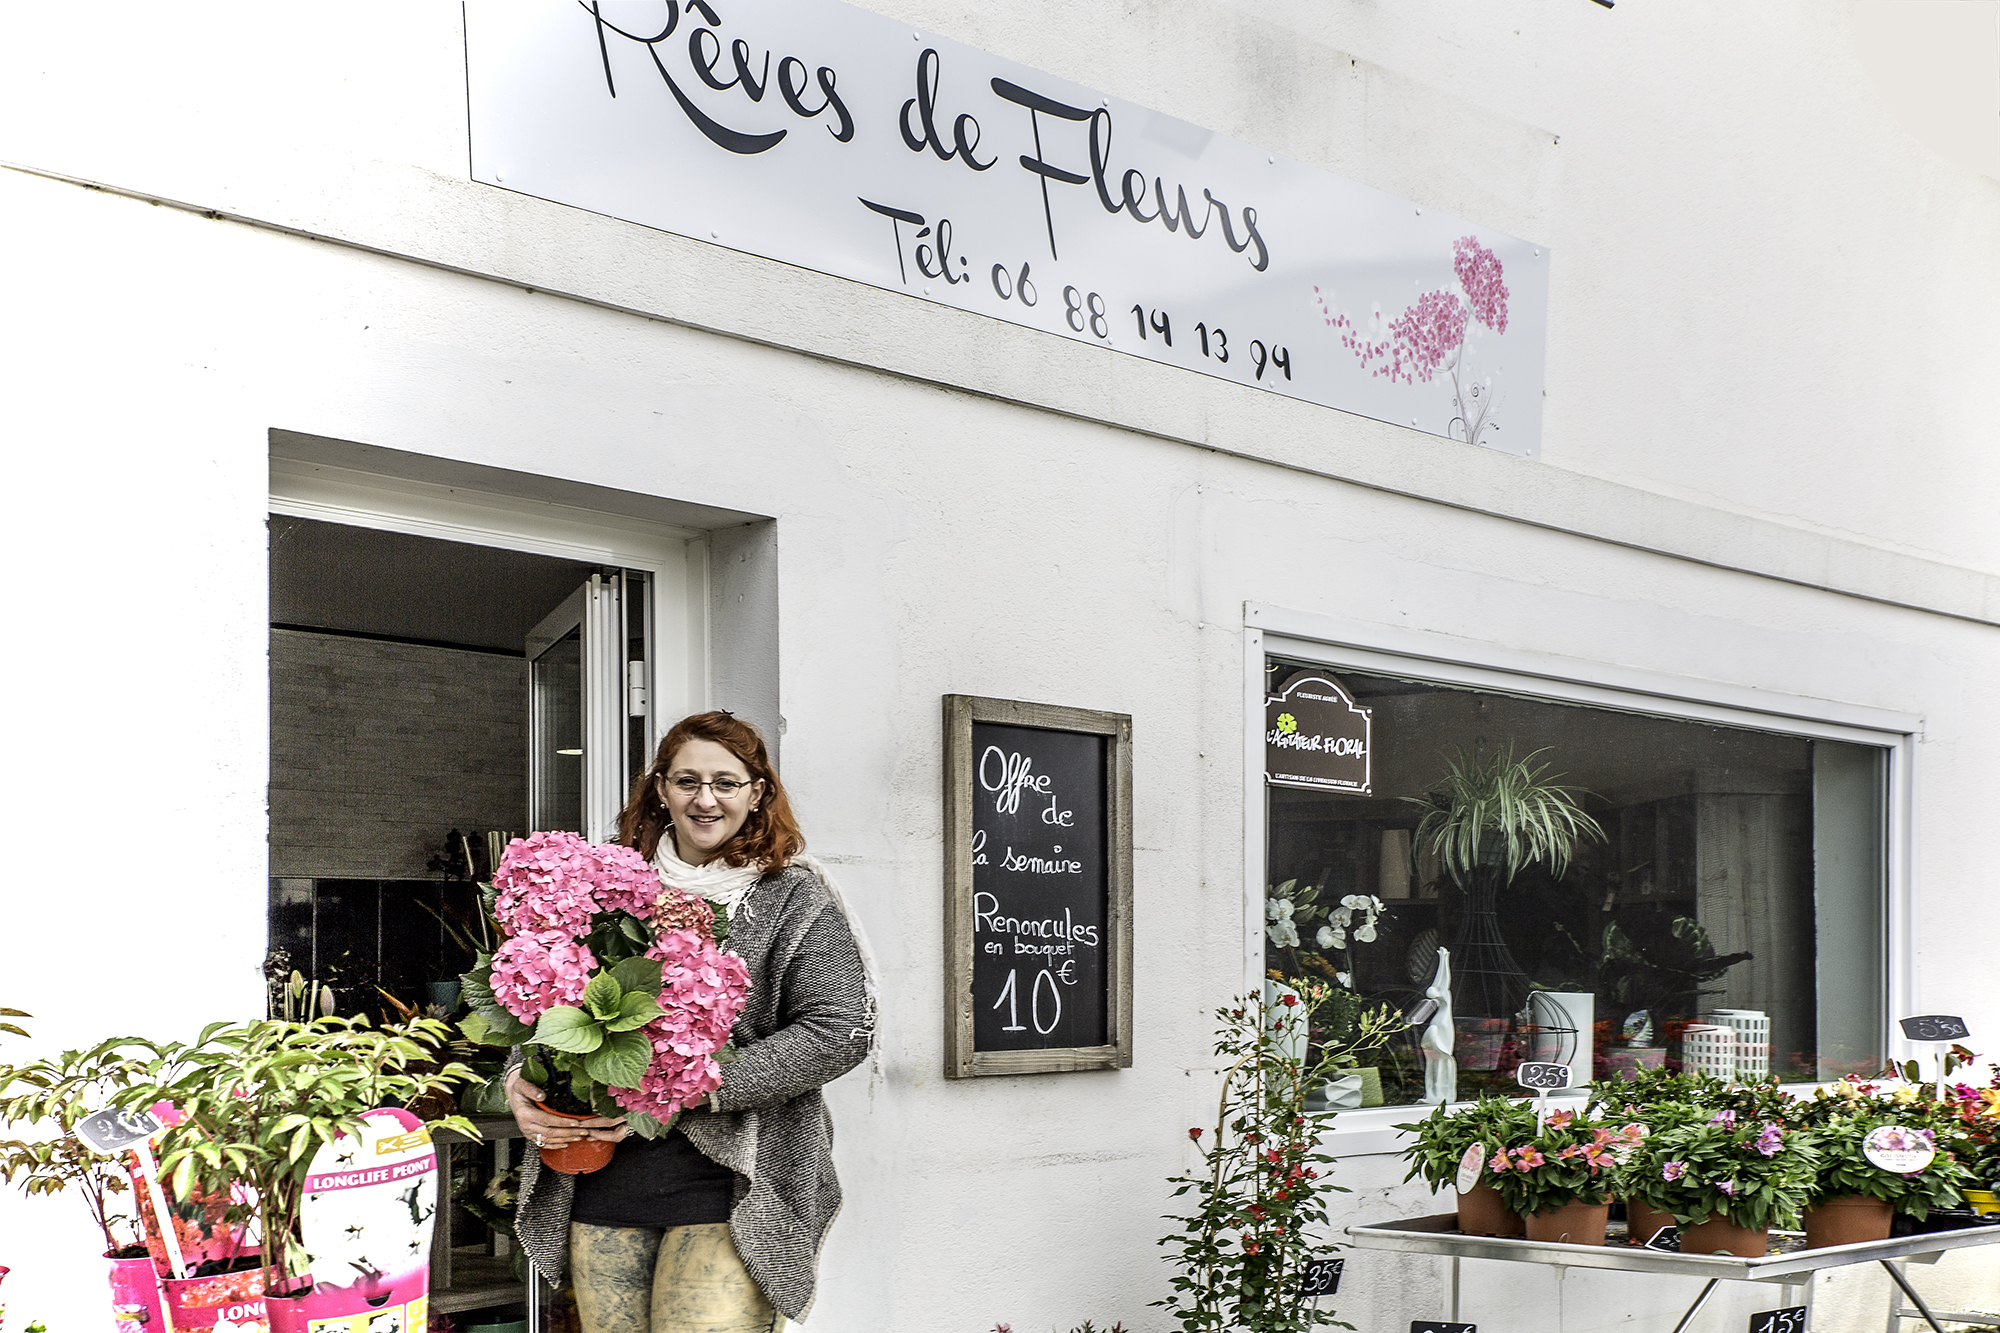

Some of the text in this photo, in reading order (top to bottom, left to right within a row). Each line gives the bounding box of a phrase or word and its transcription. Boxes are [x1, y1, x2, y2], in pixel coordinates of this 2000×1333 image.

[578, 0, 1269, 272] Rêves de Fleurs
[857, 196, 1292, 381] Tél: 06 88 14 13 94
[1323, 737, 1367, 760] FLORAL
[1041, 795, 1075, 827] de
[1000, 845, 1082, 874] semaine
[973, 891, 1099, 947] Renoncules
[985, 936, 1076, 967] en bouquet
[313, 1158, 431, 1190] LONGLIFE PEONY
